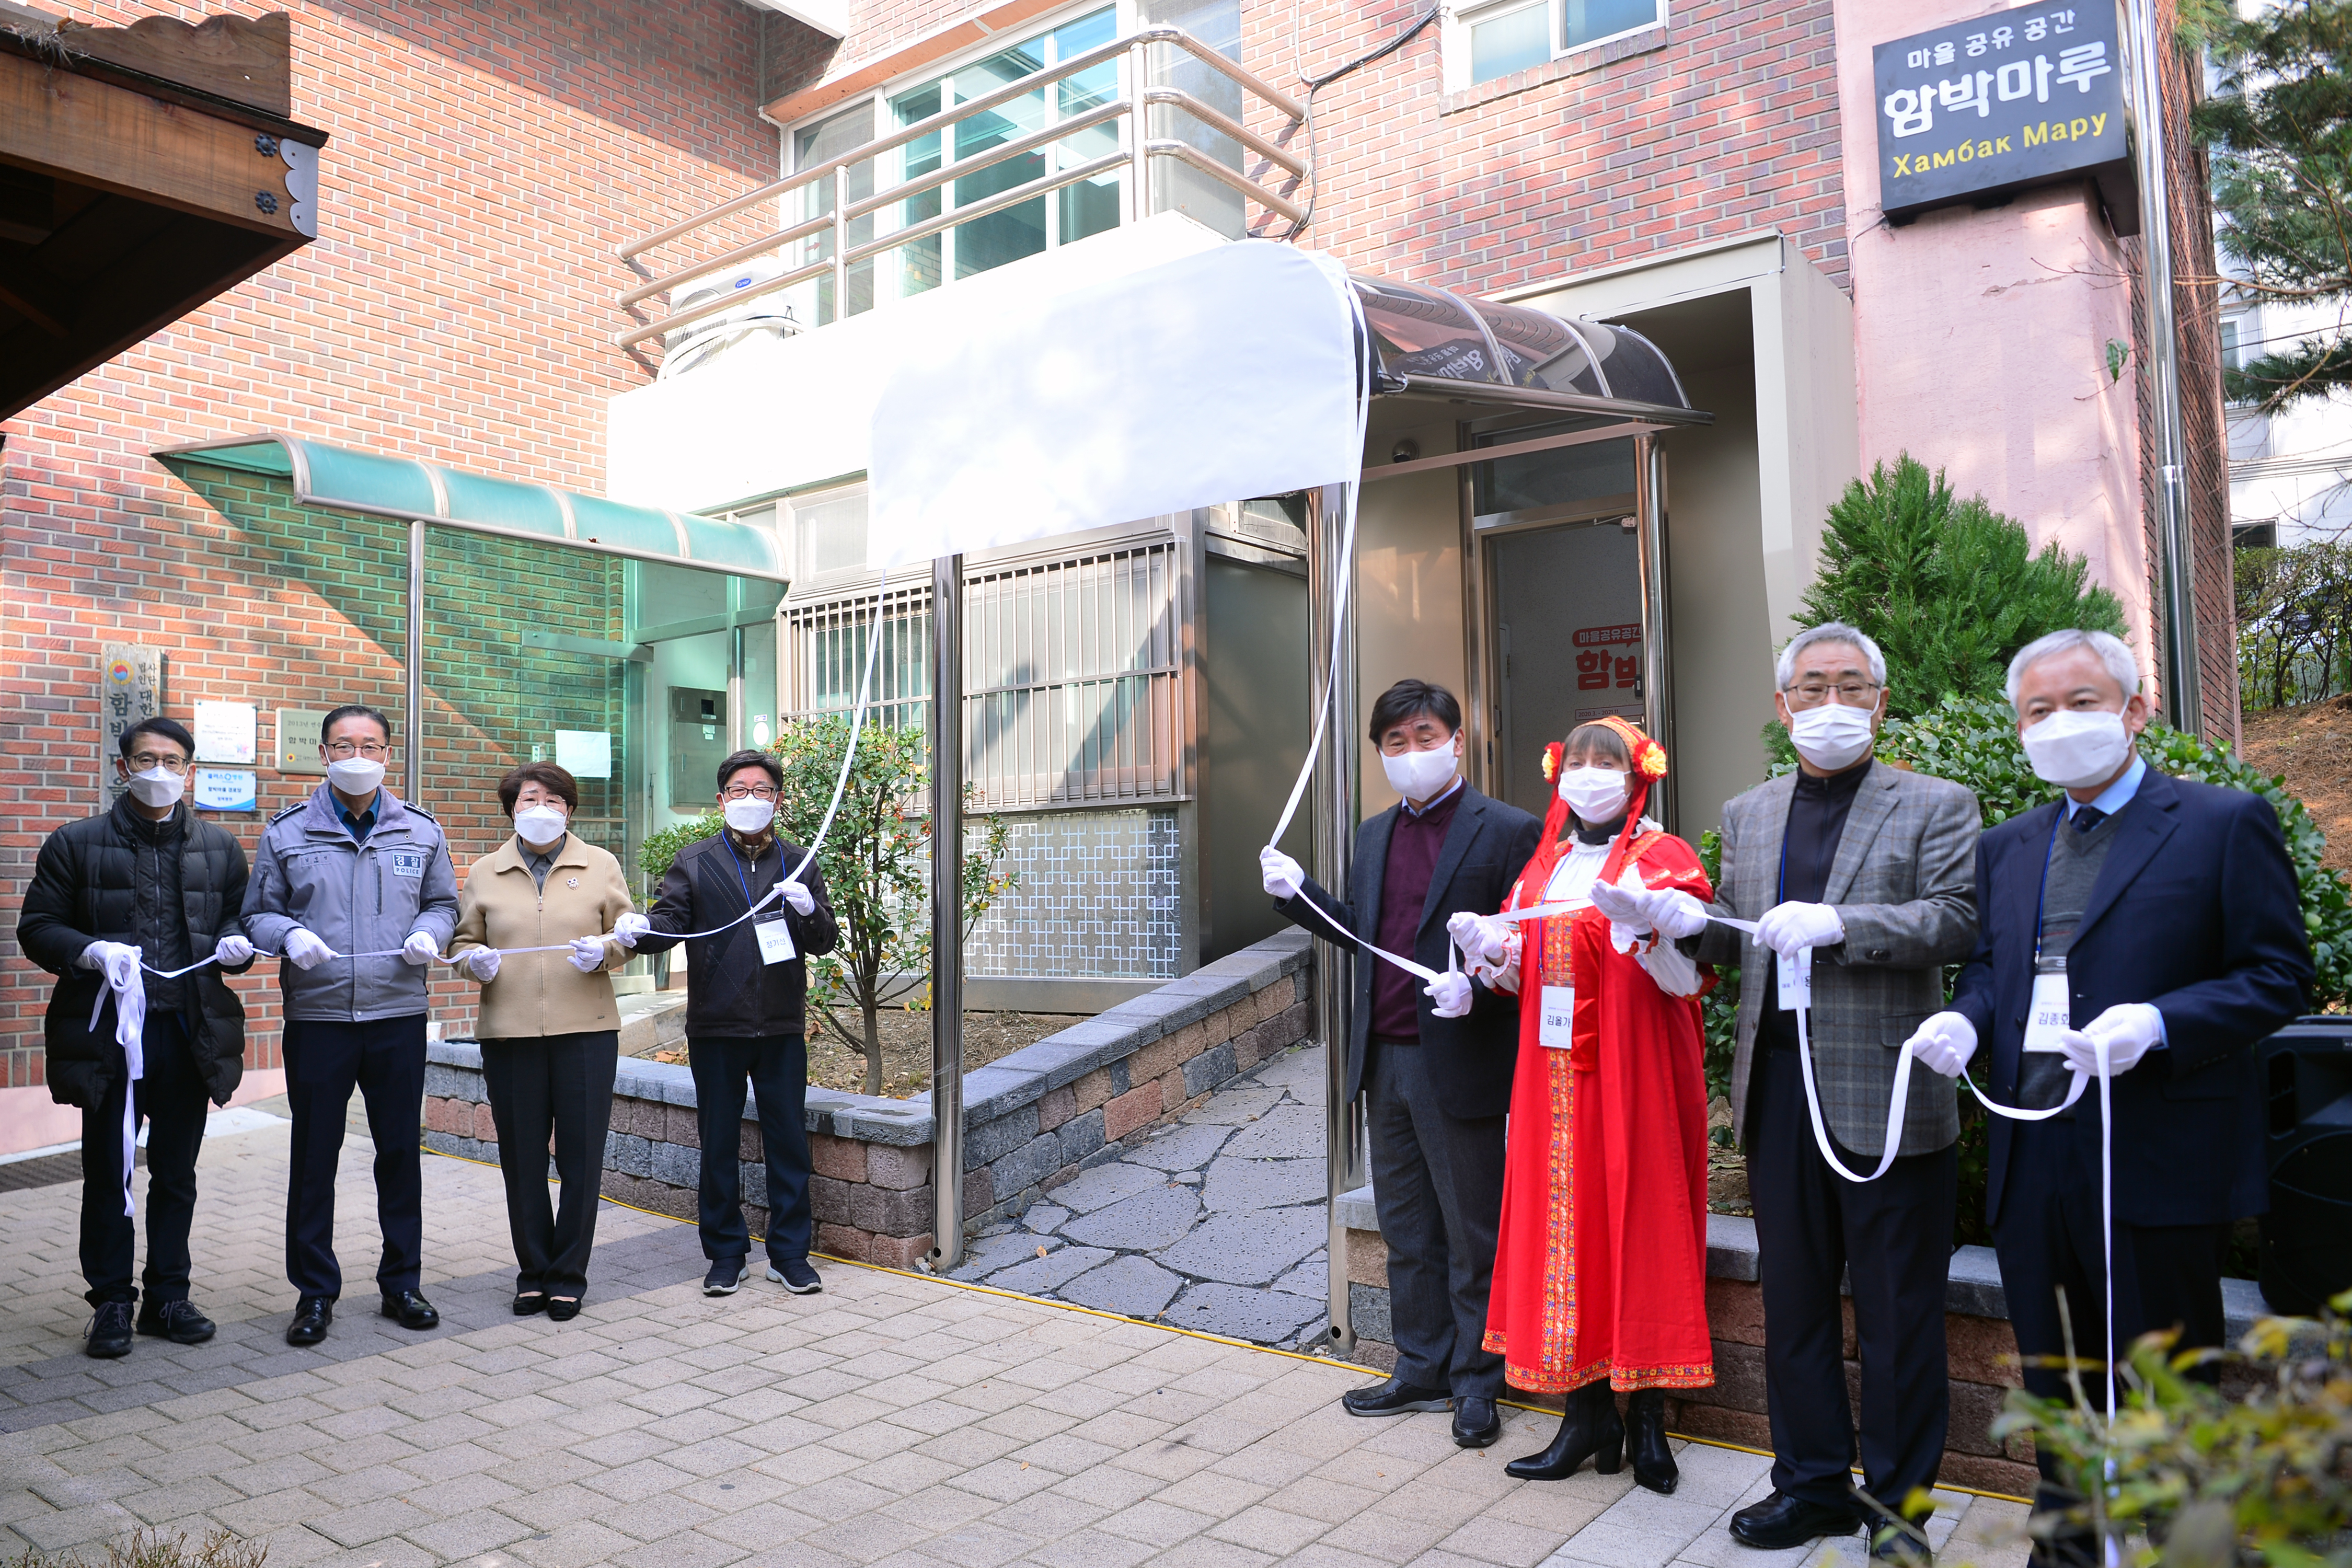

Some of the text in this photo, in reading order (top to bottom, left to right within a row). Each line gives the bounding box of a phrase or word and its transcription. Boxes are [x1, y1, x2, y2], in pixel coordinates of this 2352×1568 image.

[1907, 9, 2076, 70] 마을 공유 공간
[1883, 40, 2112, 139] 함박마루
[1892, 112, 2107, 178] Хамбак Мару
[1547, 1014, 1571, 1028] 김올가
